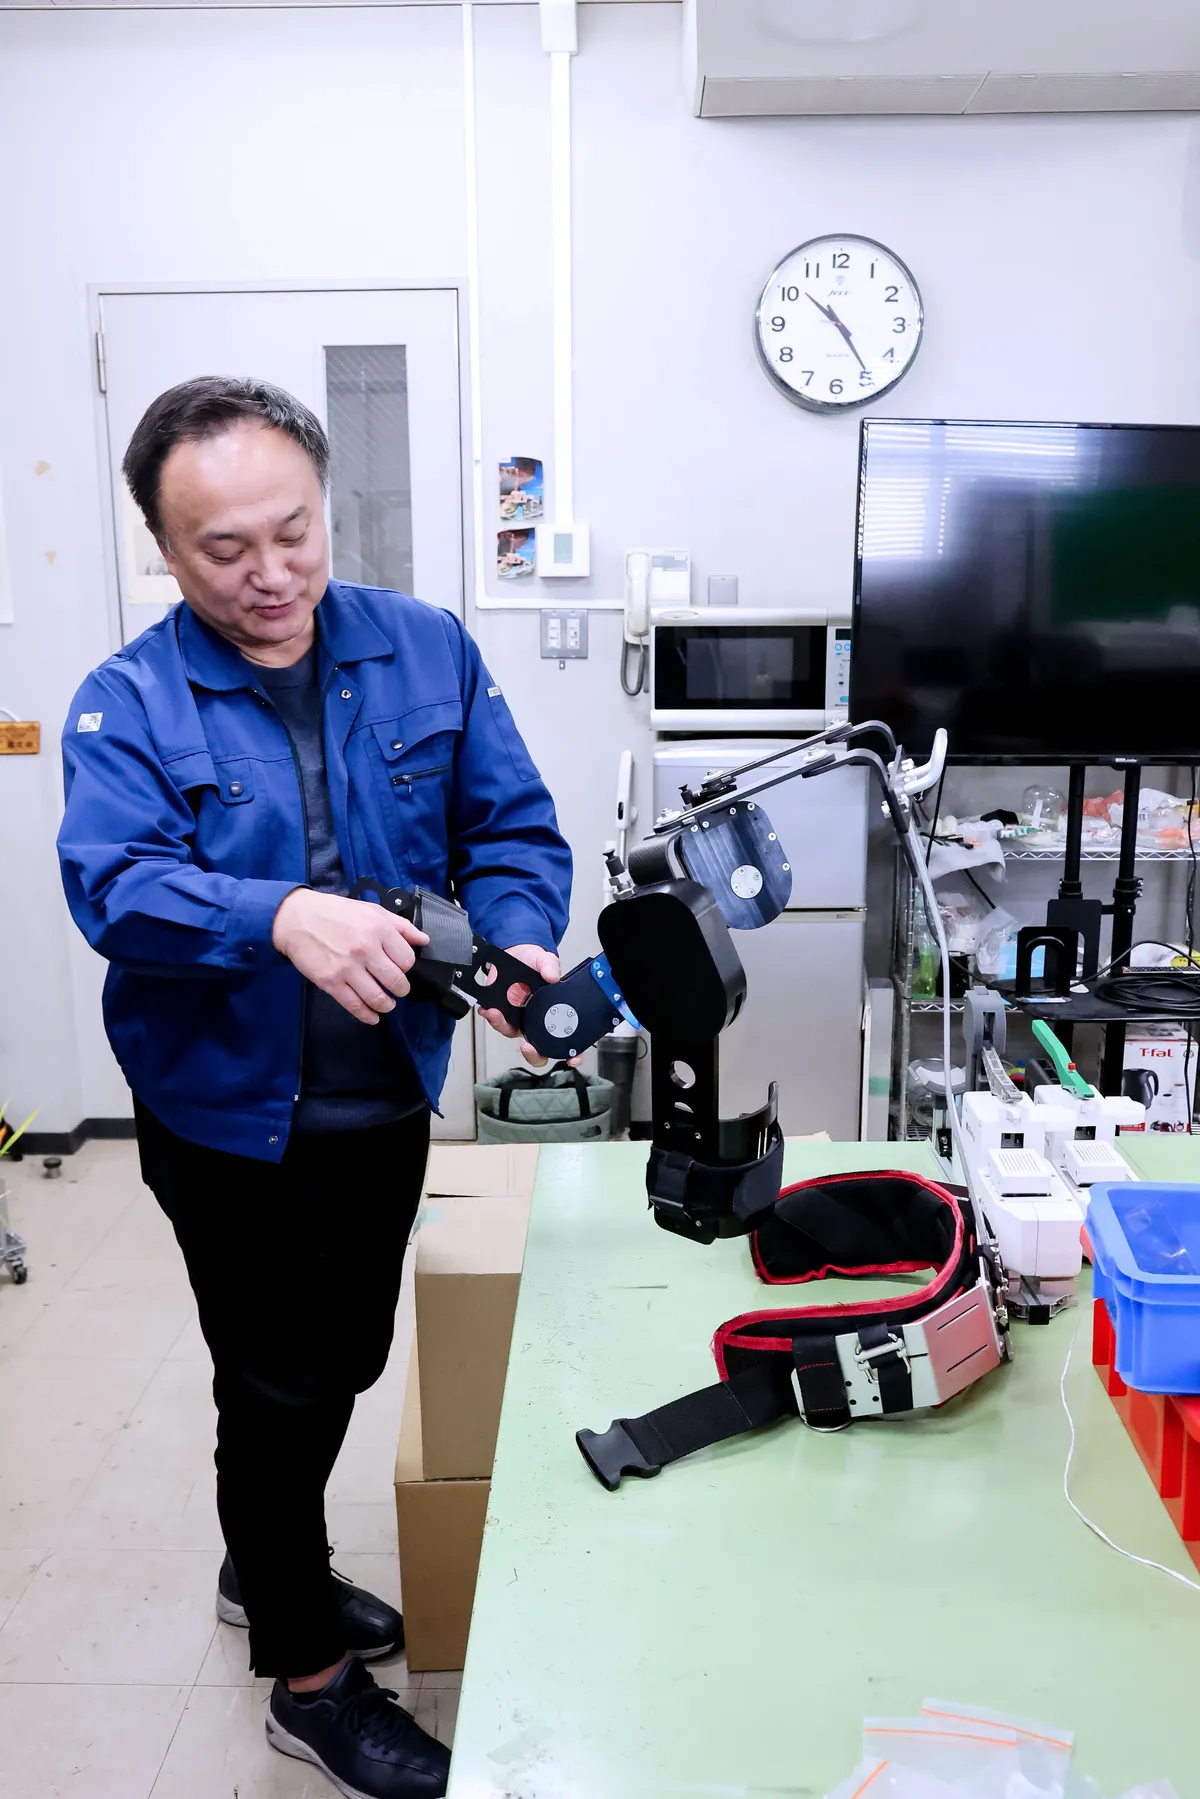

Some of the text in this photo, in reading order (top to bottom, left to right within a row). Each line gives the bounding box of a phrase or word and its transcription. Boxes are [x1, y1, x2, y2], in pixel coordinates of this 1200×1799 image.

[832, 253, 850, 268] 12
[805, 262, 820, 279] 11
[870, 262, 875, 279] 1
[781, 286, 799, 302] 10
[884, 286, 899, 302] 2
[771, 316, 786, 332] 9
[892, 317, 906, 333] 3
[779, 347, 794, 362] 8
[881, 347, 895, 363] 4
[801, 370, 815, 386] 7
[858, 371, 875, 387] 5
[829, 379, 844, 394] 6
